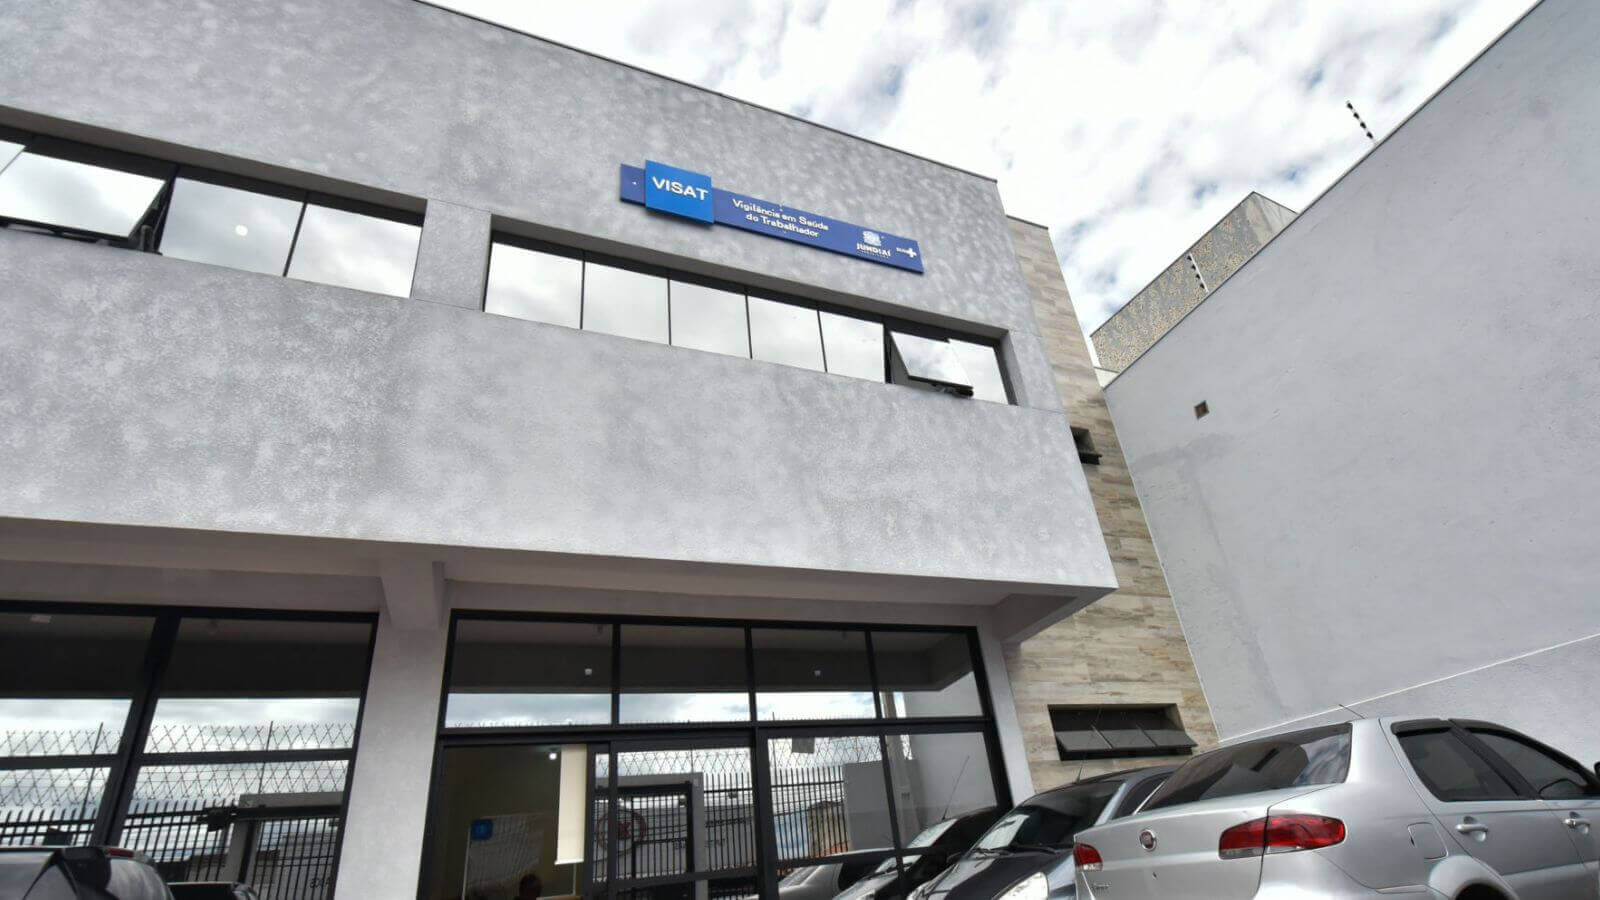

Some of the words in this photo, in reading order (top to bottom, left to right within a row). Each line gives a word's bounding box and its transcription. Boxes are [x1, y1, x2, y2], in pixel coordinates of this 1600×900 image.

[652, 176, 708, 201] VISAT
[732, 198, 780, 218] Vigilância
[782, 213, 797, 222] em
[798, 216, 829, 231] Saúde
[745, 213, 759, 222] do
[761, 215, 819, 237] Trabalhador
